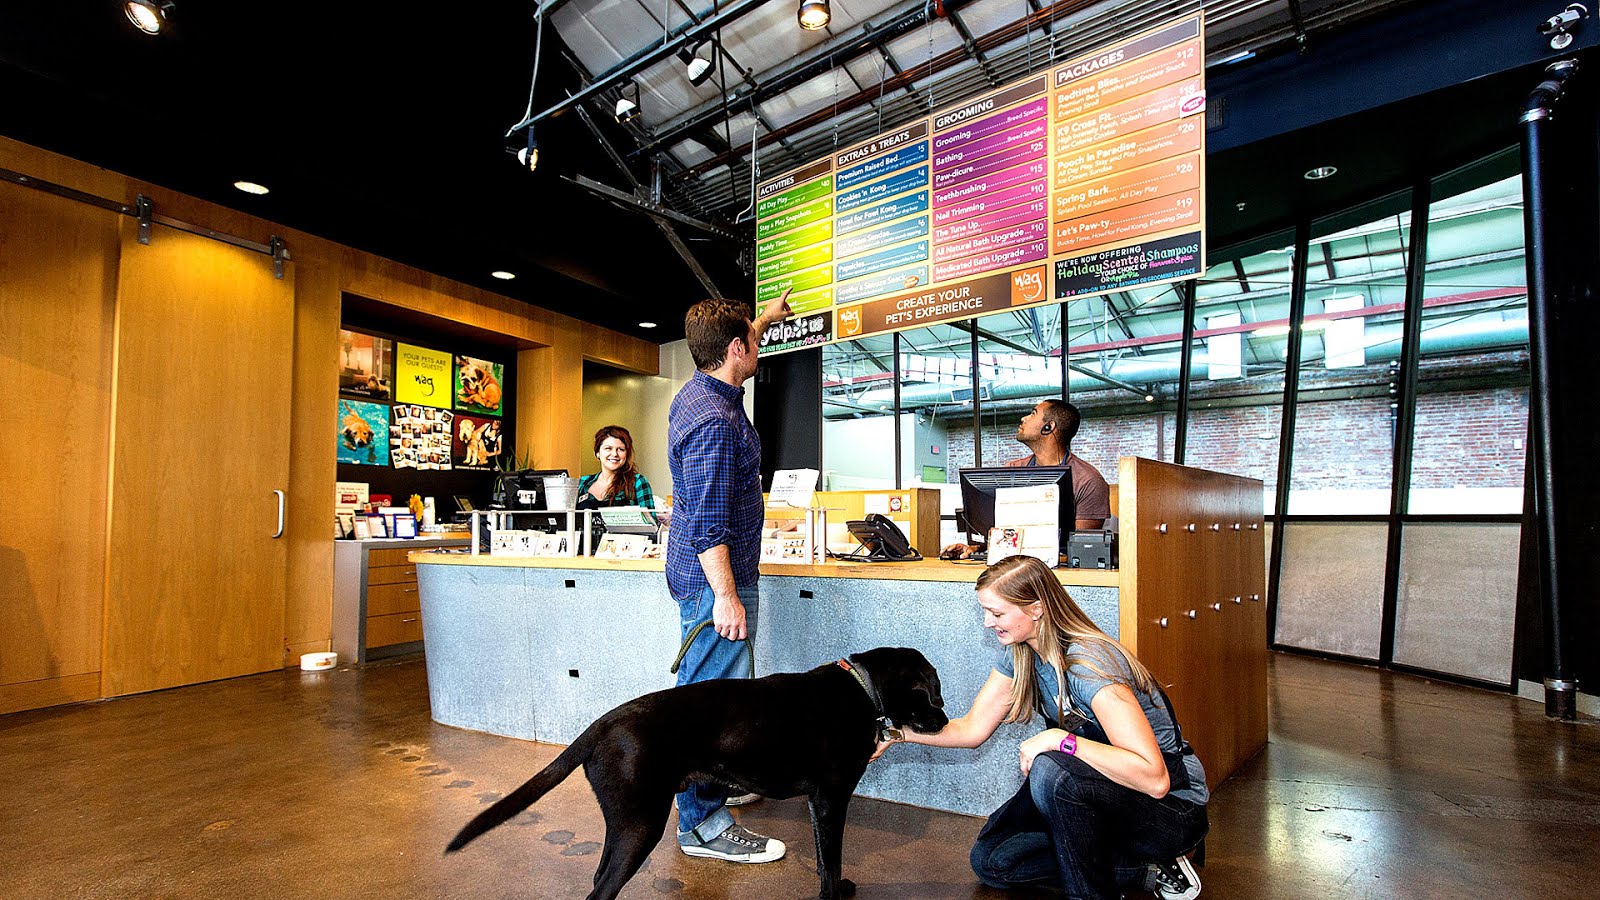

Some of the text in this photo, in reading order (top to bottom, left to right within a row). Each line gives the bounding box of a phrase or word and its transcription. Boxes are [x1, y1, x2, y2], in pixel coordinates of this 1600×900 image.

[1058, 49, 1125, 83] PACKAGES
[1058, 48, 1194, 103] Bedtime Bliss $12
[936, 100, 994, 128] GROOMING
[936, 130, 972, 148] Grooming
[1024, 105, 1044, 118] Specific
[1057, 126, 1069, 138] K9
[1072, 118, 1097, 132] Cross
[1098, 112, 1111, 124] Fit
[838, 131, 910, 165] EXTRAS & TREATS
[936, 152, 964, 166] Bathing
[1024, 126, 1044, 138] Specific
[1058, 155, 1084, 170] Pooch
[1096, 142, 1136, 158] Paradise
[1178, 122, 1194, 134] $26
[838, 144, 925, 182] Premium Raised Bed $5
[936, 166, 974, 182] Paw-dicure
[1030, 142, 1044, 152] $25
[760, 176, 795, 196] ACTIVITIES
[838, 190, 862, 204] Cookies
[870, 184, 887, 194] Kong
[936, 182, 987, 203] Teethbrushing
[1030, 163, 1043, 174] $15
[1057, 162, 1193, 207] Spring Bark $26
[1120, 192, 1129, 200] All
[1130, 188, 1143, 198] Day
[1144, 185, 1159, 195] Play
[767, 200, 776, 208] Day
[777, 197, 788, 205] Play
[864, 208, 879, 218] Fowl
[880, 204, 897, 215] Kong
[936, 184, 1044, 221] Nail Trimming $10
[760, 224, 770, 232] Stay
[774, 218, 785, 227] Play
[936, 228, 949, 237] The
[950, 224, 966, 234] Tune
[968, 221, 979, 230] Up
[1030, 202, 1044, 212] $15
[1057, 197, 1193, 238] Let's Paw-ty $19
[760, 243, 774, 253] Buddy
[936, 248, 944, 256] All
[946, 240, 972, 252] Natural
[973, 236, 990, 248] Bath
[991, 228, 1024, 243] Upgrade
[1031, 222, 1044, 232] $10
[760, 262, 780, 274] Morning
[936, 262, 972, 274] Medicated
[974, 256, 990, 267] Bath
[992, 248, 1024, 263] Upgrade
[1032, 243, 1044, 252] $10
[1057, 246, 1142, 270] WE'RE NOW OFFERING
[1057, 244, 1198, 280] Holiday Scented Shampoos
[1101, 268, 1116, 277] YOUR
[1117, 264, 1138, 274] CHOICE
[760, 279, 792, 294] Evening Stroll
[896, 294, 936, 311] CREATE
[938, 286, 970, 302] YOUR
[885, 297, 984, 325] PET'S EXPERIENCE
[403, 352, 420, 360] YOUR
[422, 356, 434, 364] PETS
[421, 362, 444, 372] GUESTS
